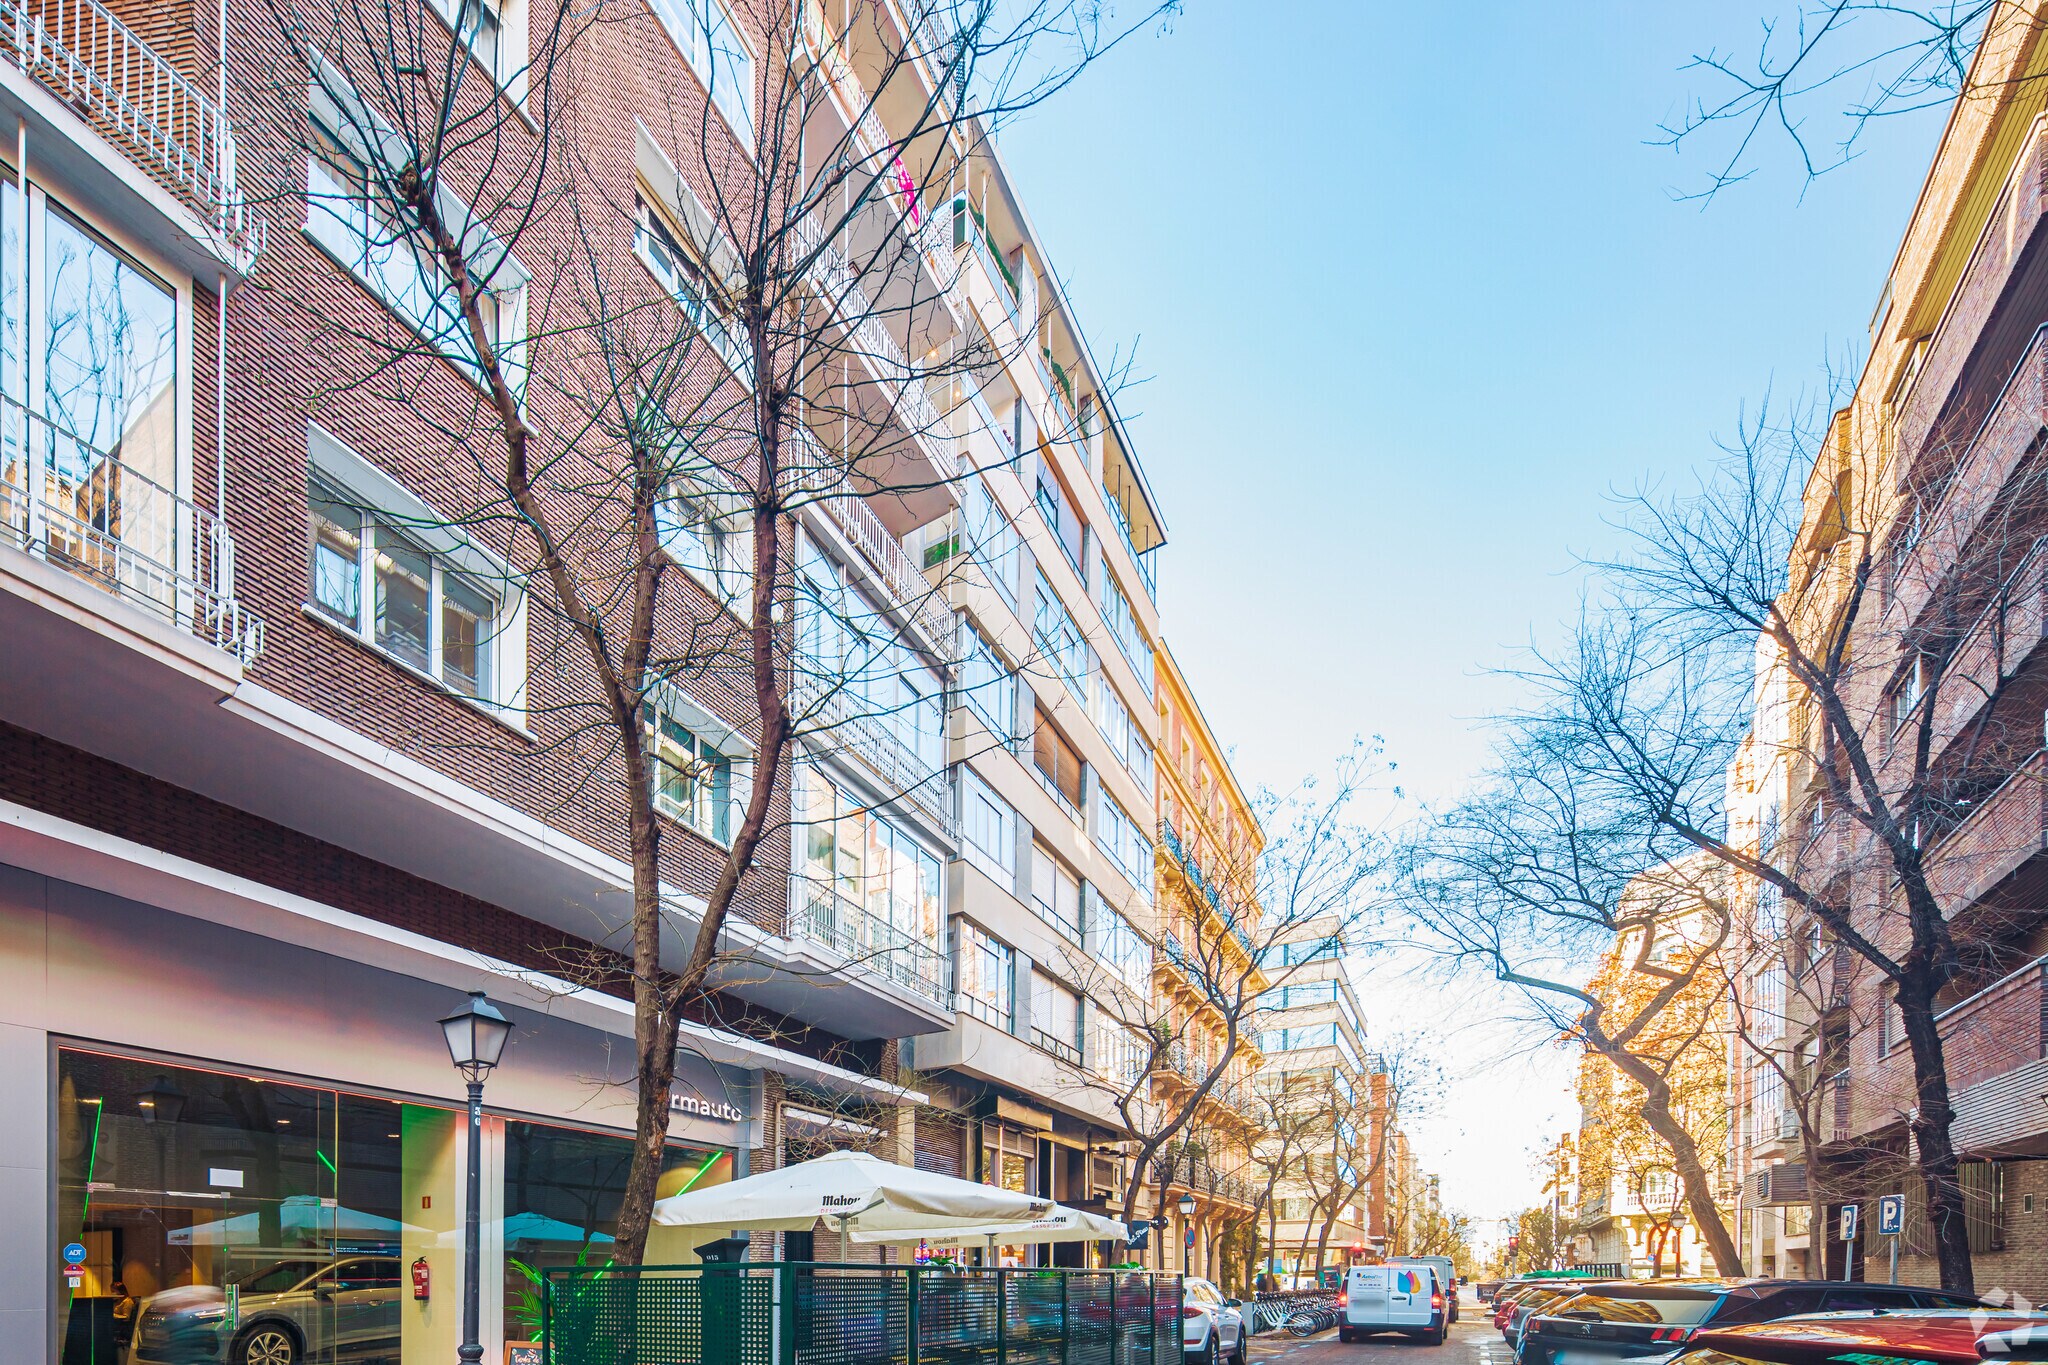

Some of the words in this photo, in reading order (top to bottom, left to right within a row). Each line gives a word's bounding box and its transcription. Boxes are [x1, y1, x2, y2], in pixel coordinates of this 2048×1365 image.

[671, 1093, 742, 1122] rmauto
[1842, 1210, 1852, 1237] P
[1883, 1201, 1897, 1230] P
